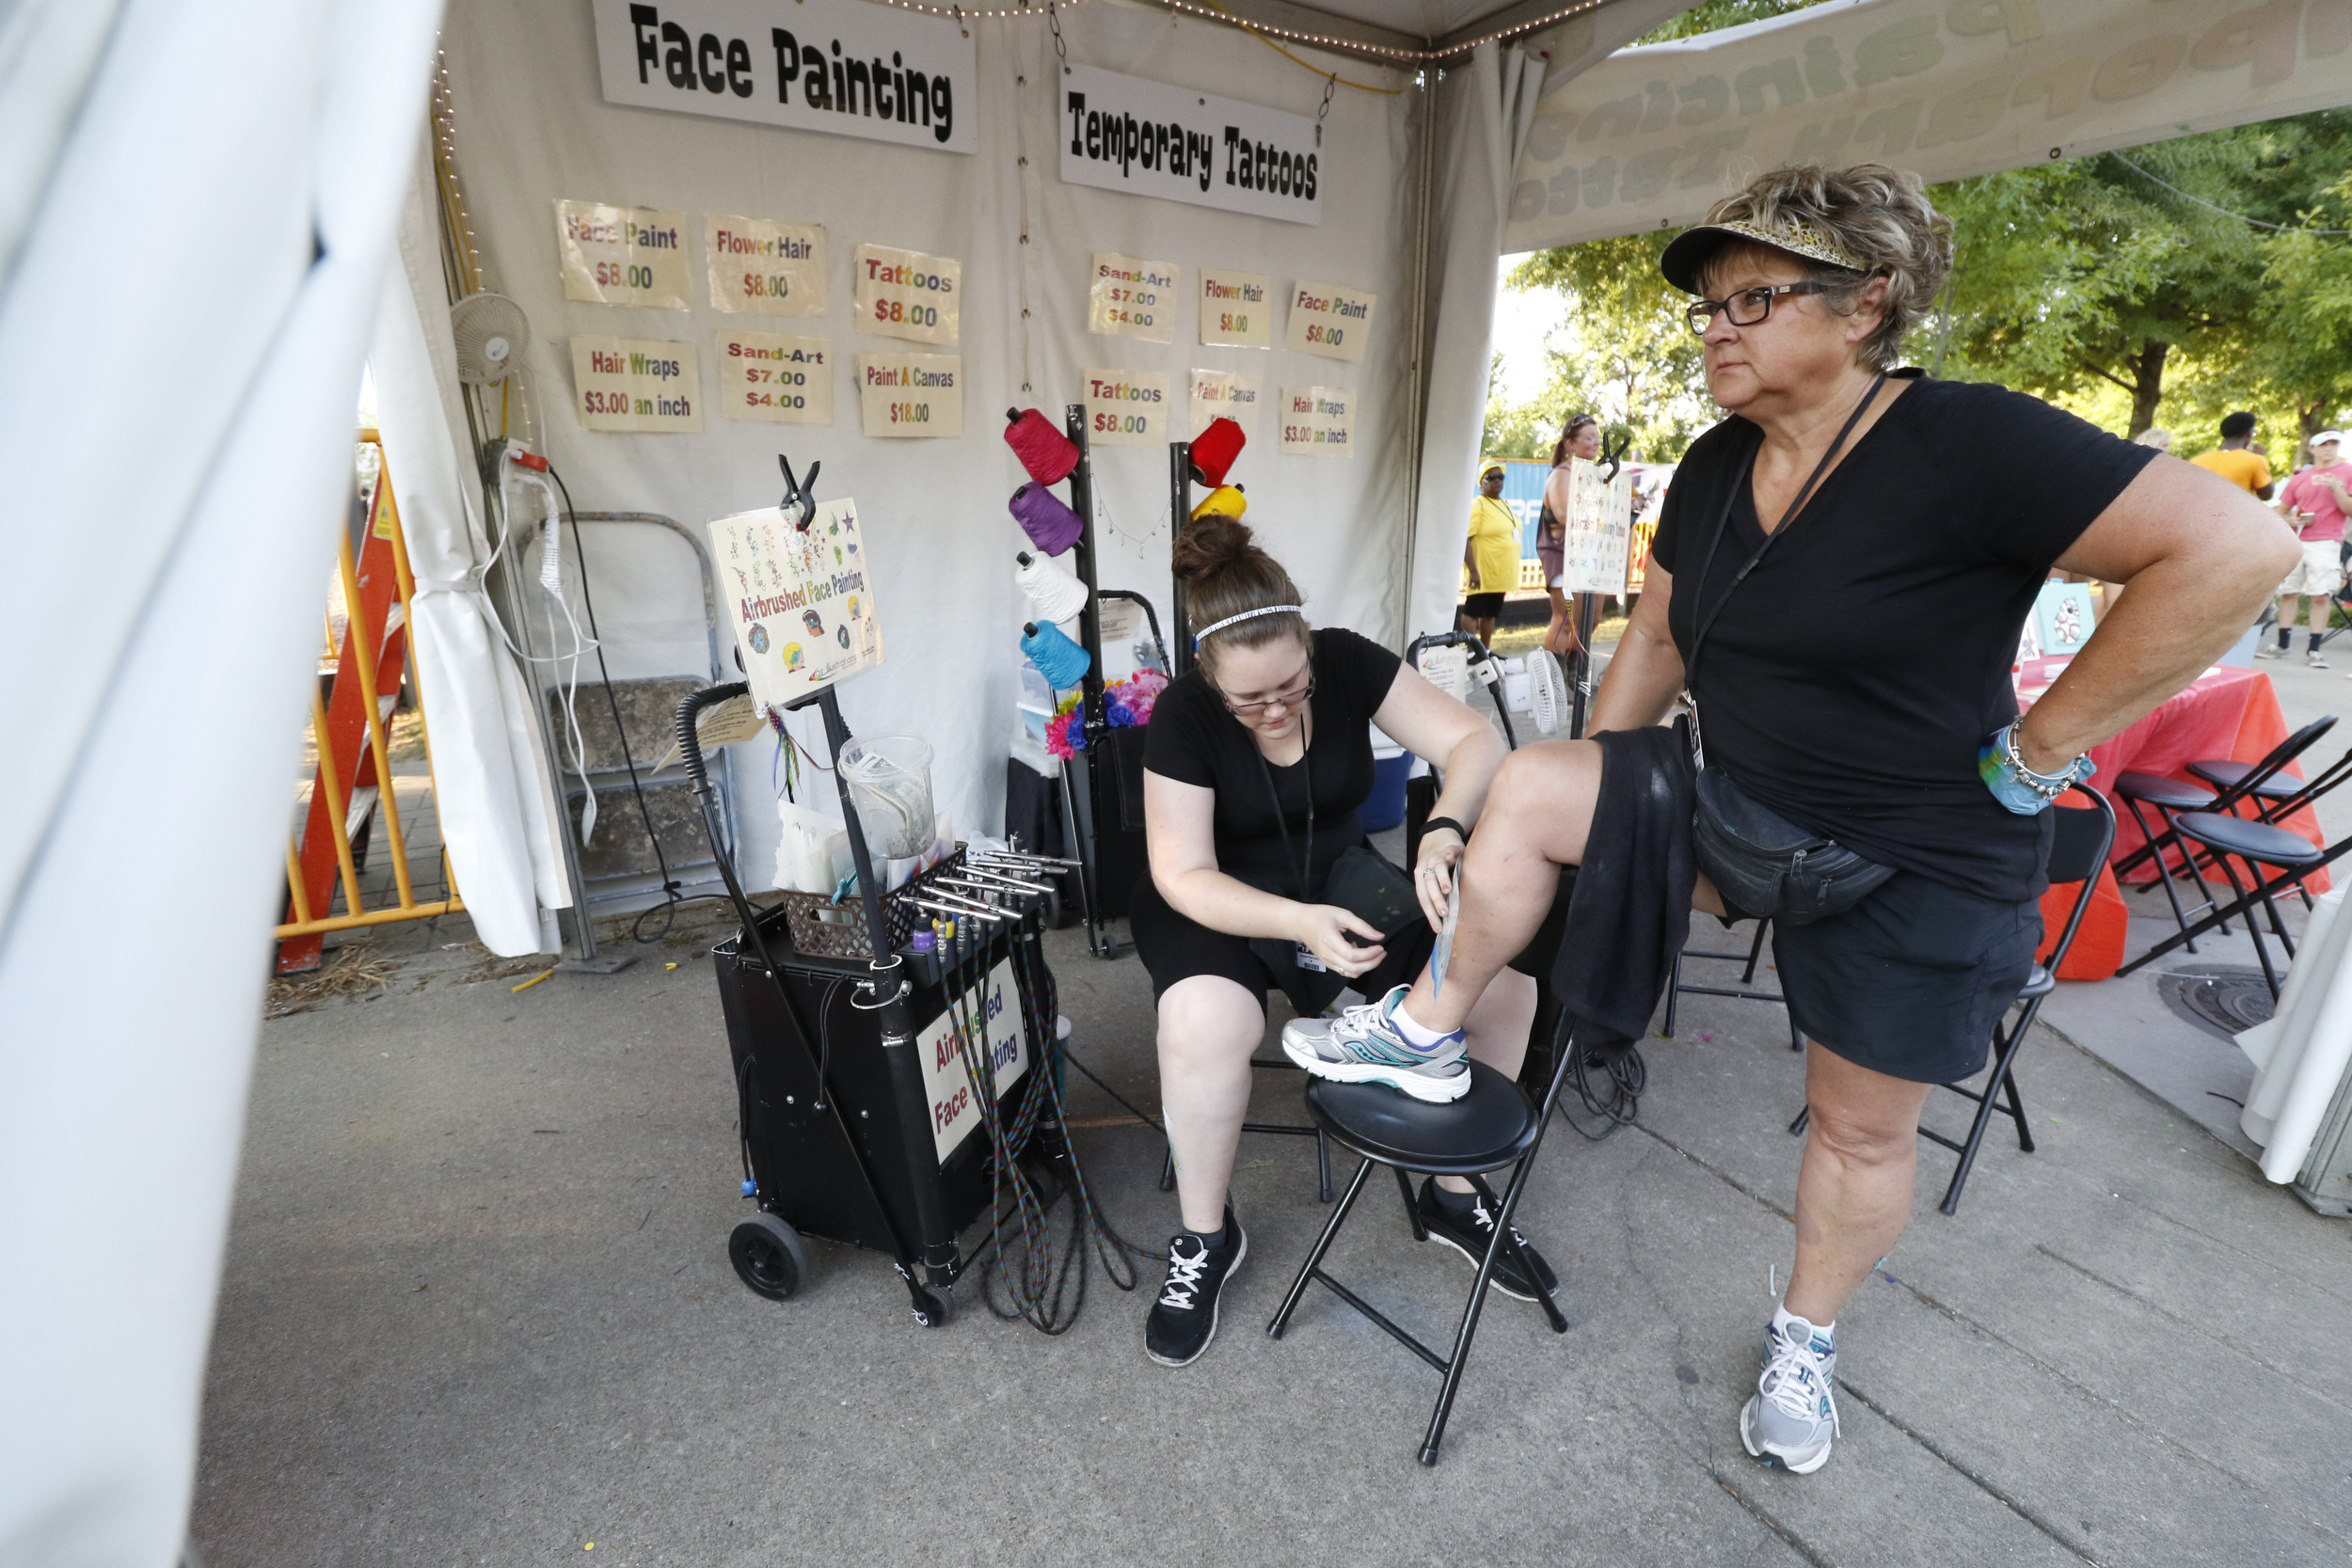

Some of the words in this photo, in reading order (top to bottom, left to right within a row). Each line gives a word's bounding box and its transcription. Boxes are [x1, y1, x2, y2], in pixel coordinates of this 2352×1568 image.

[629, 3, 754, 98] Face
[771, 27, 953, 143] Painting
[1068, 90, 1214, 193] Temporary
[1224, 125, 1318, 201] Tattoos
[567, 216, 618, 243] Face
[625, 222, 678, 250] Paint
[717, 230, 774, 257] Flower
[779, 235, 813, 261] Hair
[596, 261, 654, 289] $8.00
[743, 273, 789, 298] $8.00
[866, 258, 954, 293] Tattoos
[1099, 264, 1172, 288] Sand-Art
[1111, 288, 1156, 308] $7.00
[1205, 279, 1242, 301] Flower
[1244, 283, 1264, 303] Hair
[874, 297, 939, 328] $8.00
[1108, 309, 1153, 326] $4.00
[1296, 291, 1329, 313] Face
[1332, 296, 1369, 320] Paint
[1220, 313, 1248, 333] $8.00
[1306, 325, 1344, 346] $8.00
[727, 342, 825, 366] Sand-Art
[592, 351, 626, 375] Hair
[629, 352, 680, 382] Wraps
[746, 368, 806, 387] $7.00
[866, 365, 898, 387] Paint
[900, 367, 911, 388] A
[914, 367, 954, 388] Canvas
[585, 390, 629, 416] $3.00
[634, 395, 653, 416] an
[658, 393, 691, 417] inch
[746, 391, 806, 409] $4.00
[1090, 380, 1163, 403] Tattoos
[1198, 381, 1219, 402] Paint
[1229, 385, 1256, 404] Canvas
[890, 402, 930, 424] $18.00
[1293, 396, 1314, 414] Hair
[1316, 398, 1345, 419] Wraps
[1094, 412, 1147, 435] $8.00
[1284, 425, 1311, 443] $3.00
[1313, 429, 1326, 443] an
[1327, 428, 1347, 444] inch
[740, 583, 808, 623] Airbrushed
[806, 580, 833, 604] Face
[830, 568, 865, 595] Painting
[934, 1085, 968, 1135] Face
